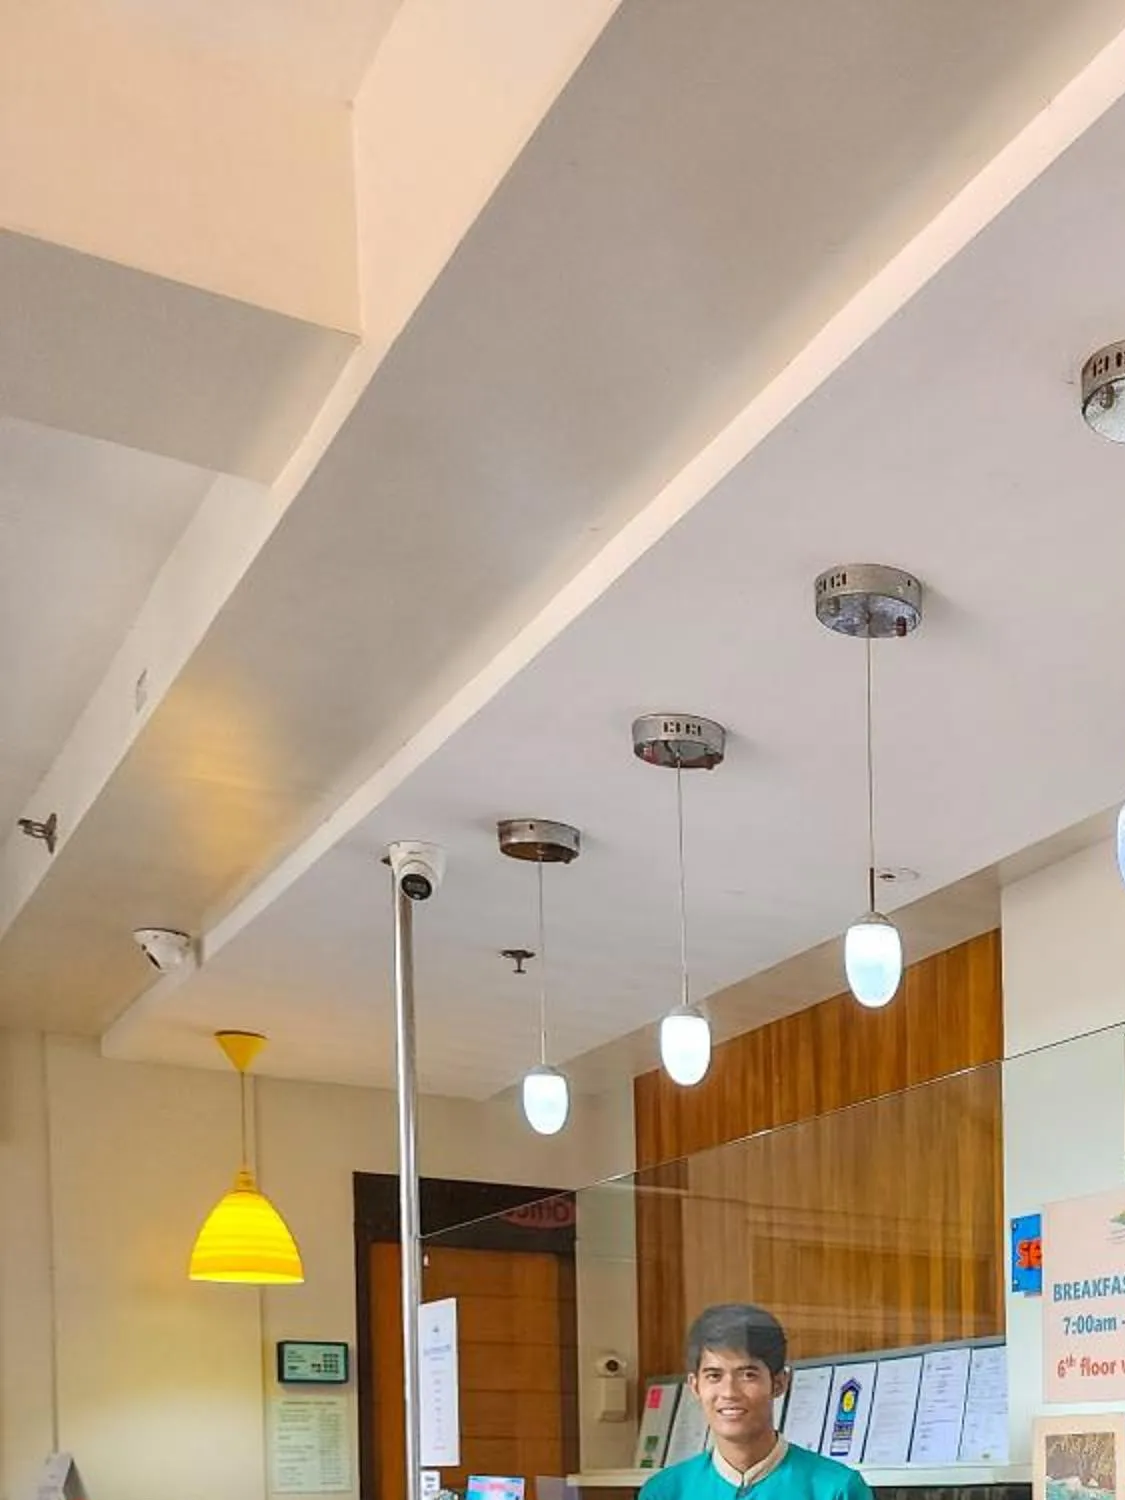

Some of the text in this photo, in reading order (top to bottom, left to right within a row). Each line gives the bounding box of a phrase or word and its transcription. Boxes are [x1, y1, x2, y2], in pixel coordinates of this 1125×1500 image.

[1063, 1315, 1117, 1335] 7:00am
[1057, 1354, 1076, 1379] 6th
[1080, 1356, 1117, 1377] floor
